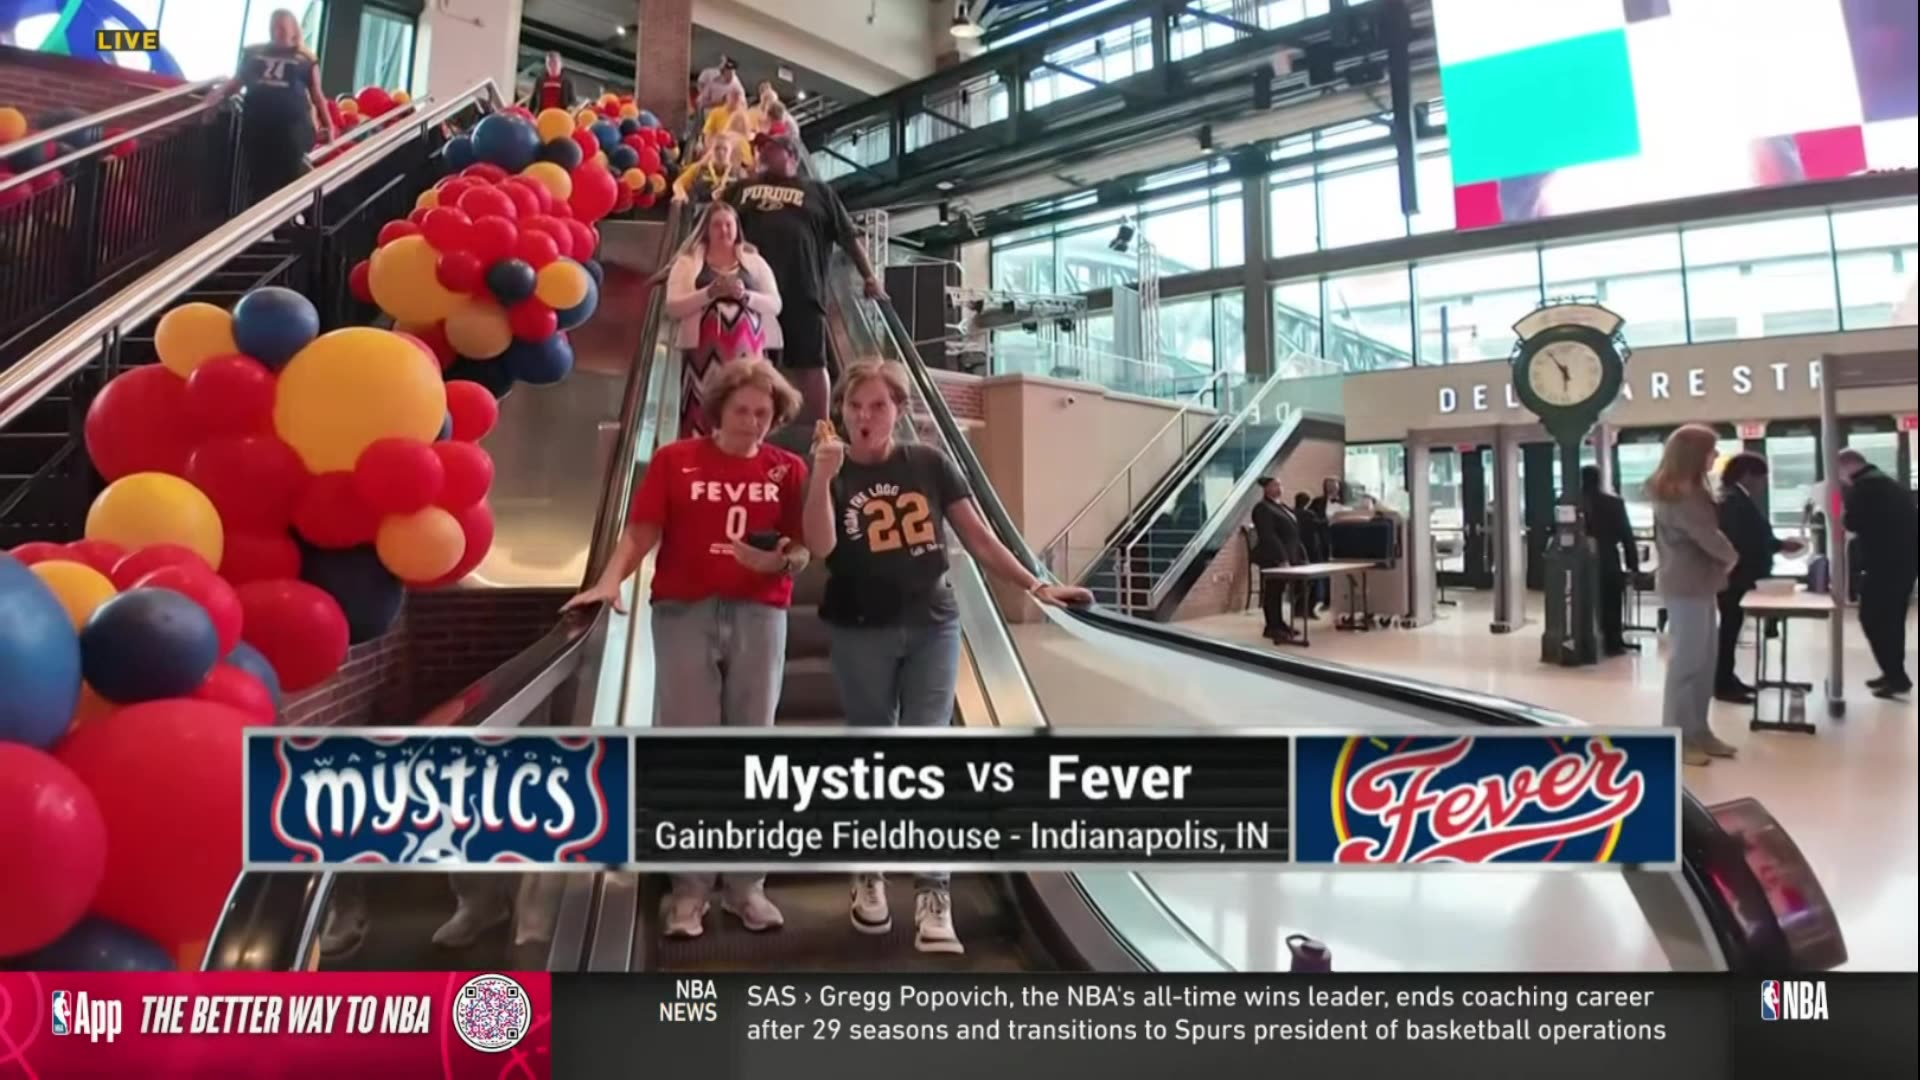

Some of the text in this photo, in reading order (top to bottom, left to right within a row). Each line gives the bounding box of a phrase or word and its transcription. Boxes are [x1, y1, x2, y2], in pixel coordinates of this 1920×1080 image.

[691, 480, 780, 502] FEVER
[725, 505, 748, 540] 0
[863, 491, 936, 553] 22
